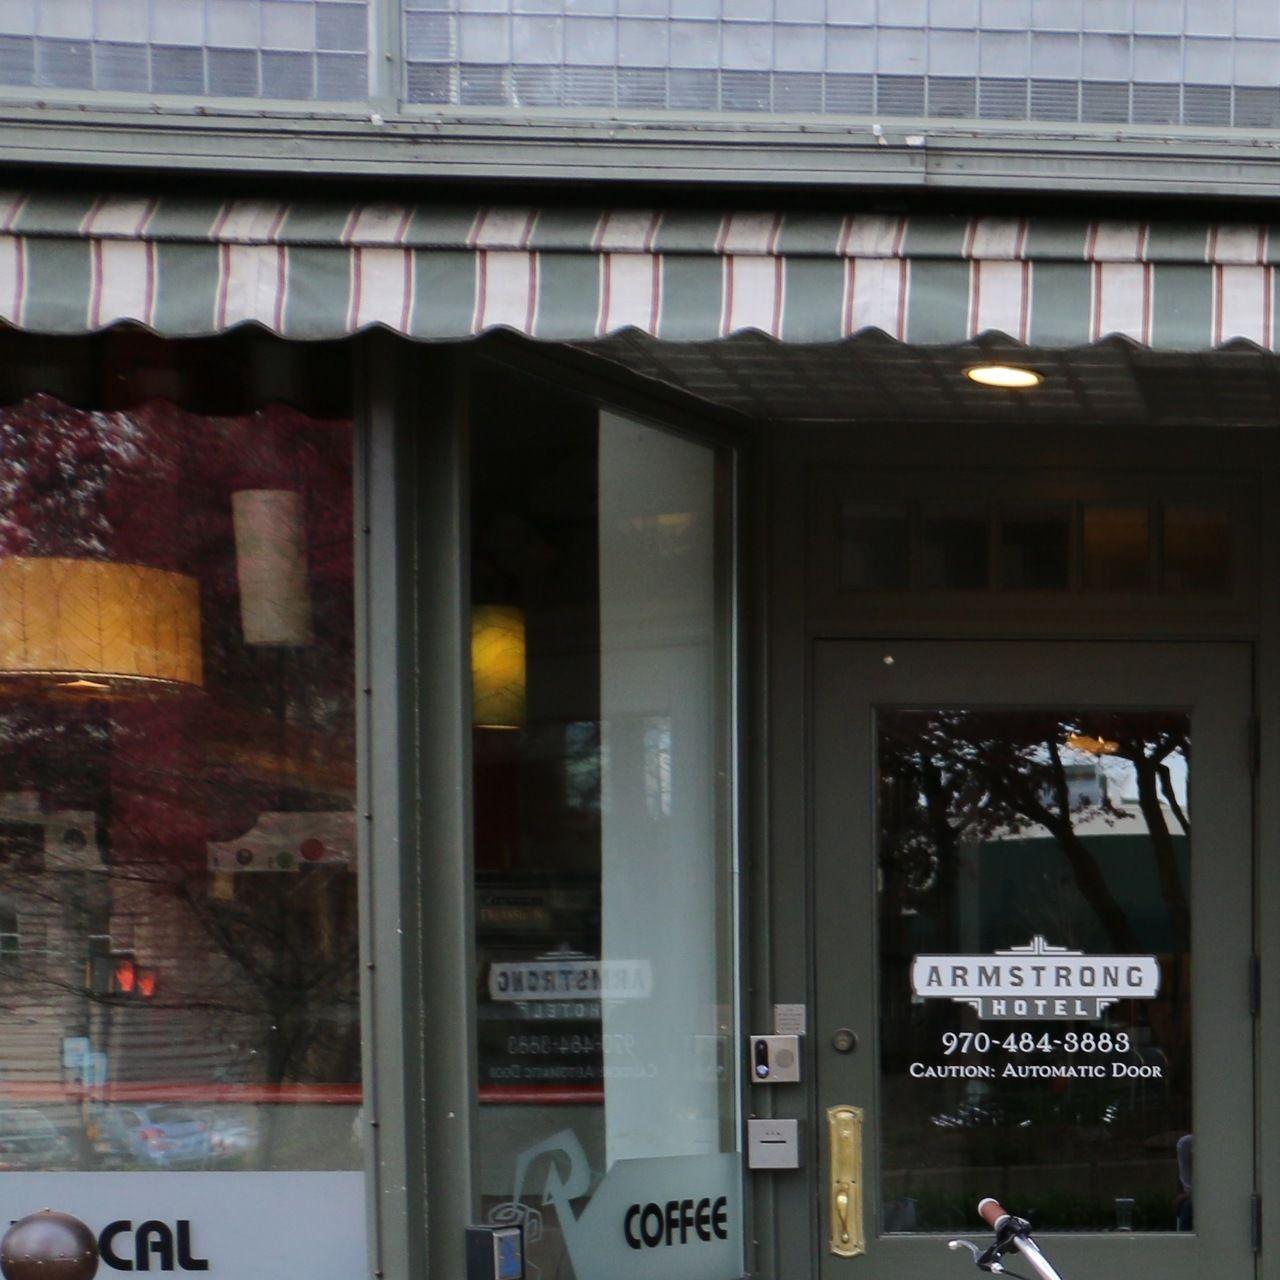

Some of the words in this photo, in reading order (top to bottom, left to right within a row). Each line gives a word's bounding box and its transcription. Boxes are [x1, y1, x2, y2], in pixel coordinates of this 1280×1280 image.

[926, 964, 1144, 988] ARMSTRONG
[992, 1000, 1087, 1016] HOTEL
[942, 1032, 1130, 1055] 970-484-3883
[623, 1196, 729, 1250] COFFEE
